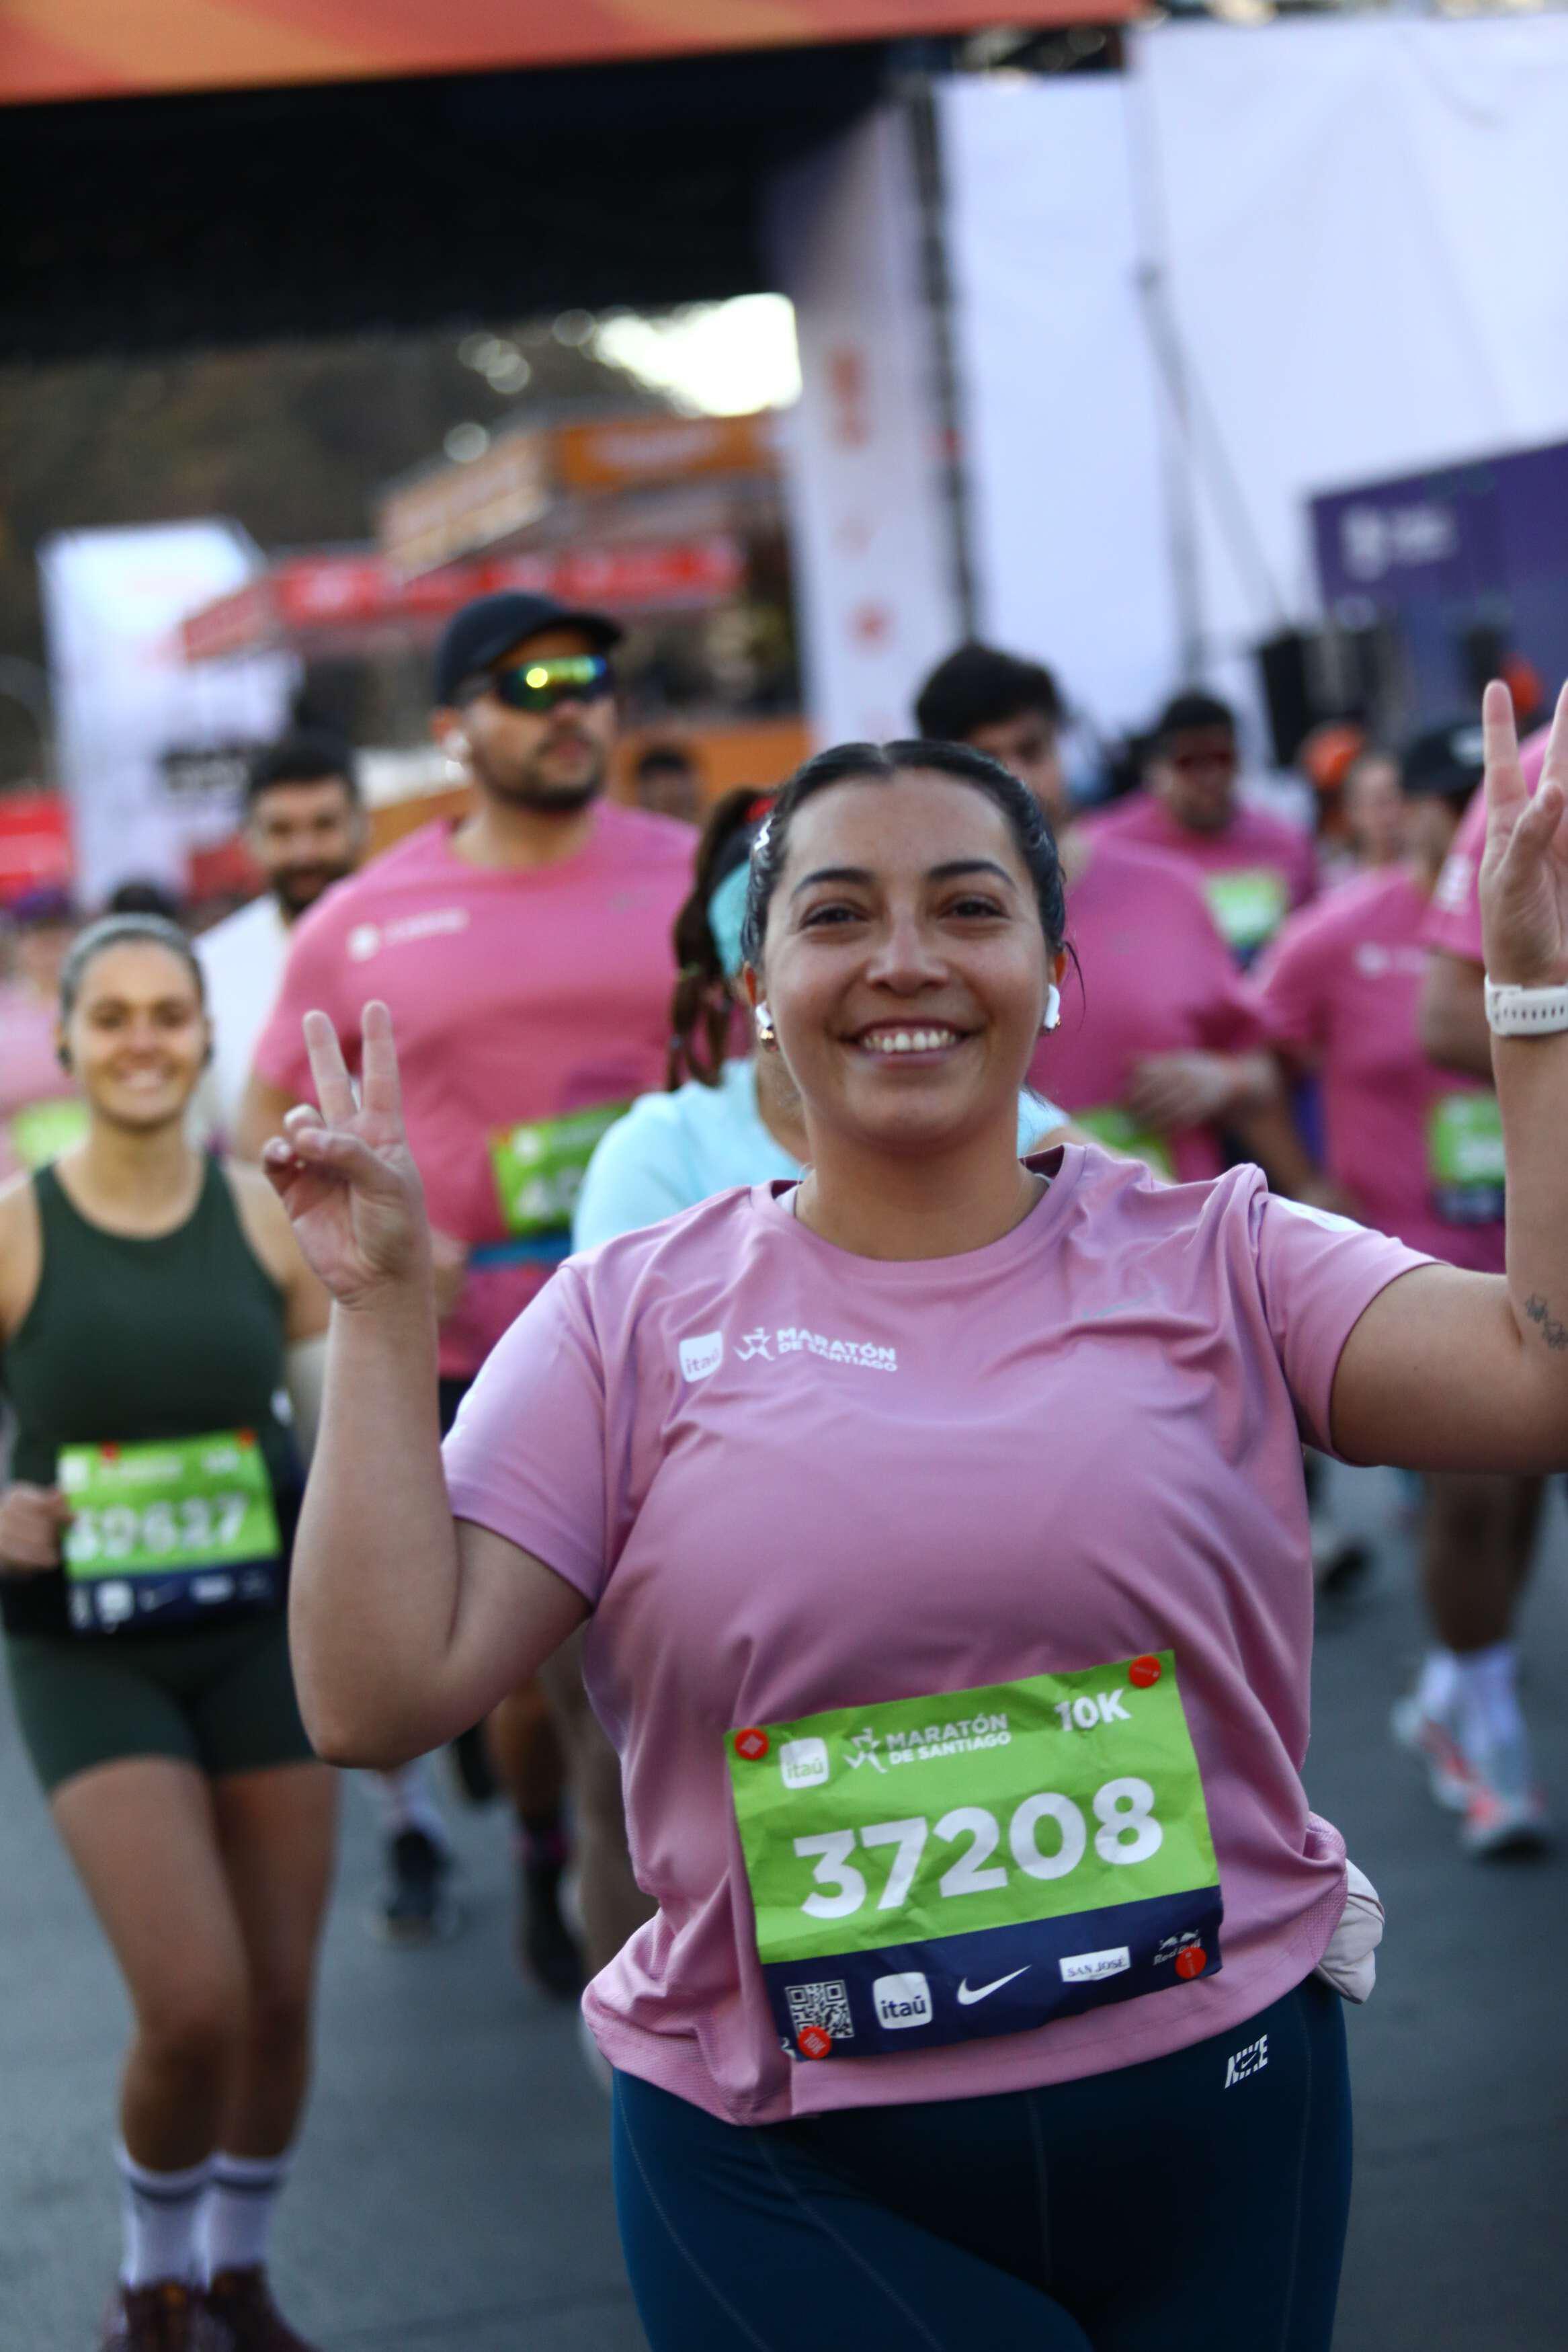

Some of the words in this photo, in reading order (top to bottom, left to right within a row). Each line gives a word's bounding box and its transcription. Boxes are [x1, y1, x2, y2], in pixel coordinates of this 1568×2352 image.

[777, 1327, 895, 1362] MARATÓN
[778, 1341, 803, 1354] DE
[1054, 1688, 1132, 1732] 10K
[886, 1713, 1007, 1749] MARATÓN
[889, 1748, 914, 1765] DE
[918, 1732, 1012, 1759] SANTIAGO
[787, 1758, 824, 1779] itaú
[794, 1777, 1163, 1918] 37208
[1067, 1964, 1092, 1977] SAN
[880, 1995, 926, 2019] itaú
